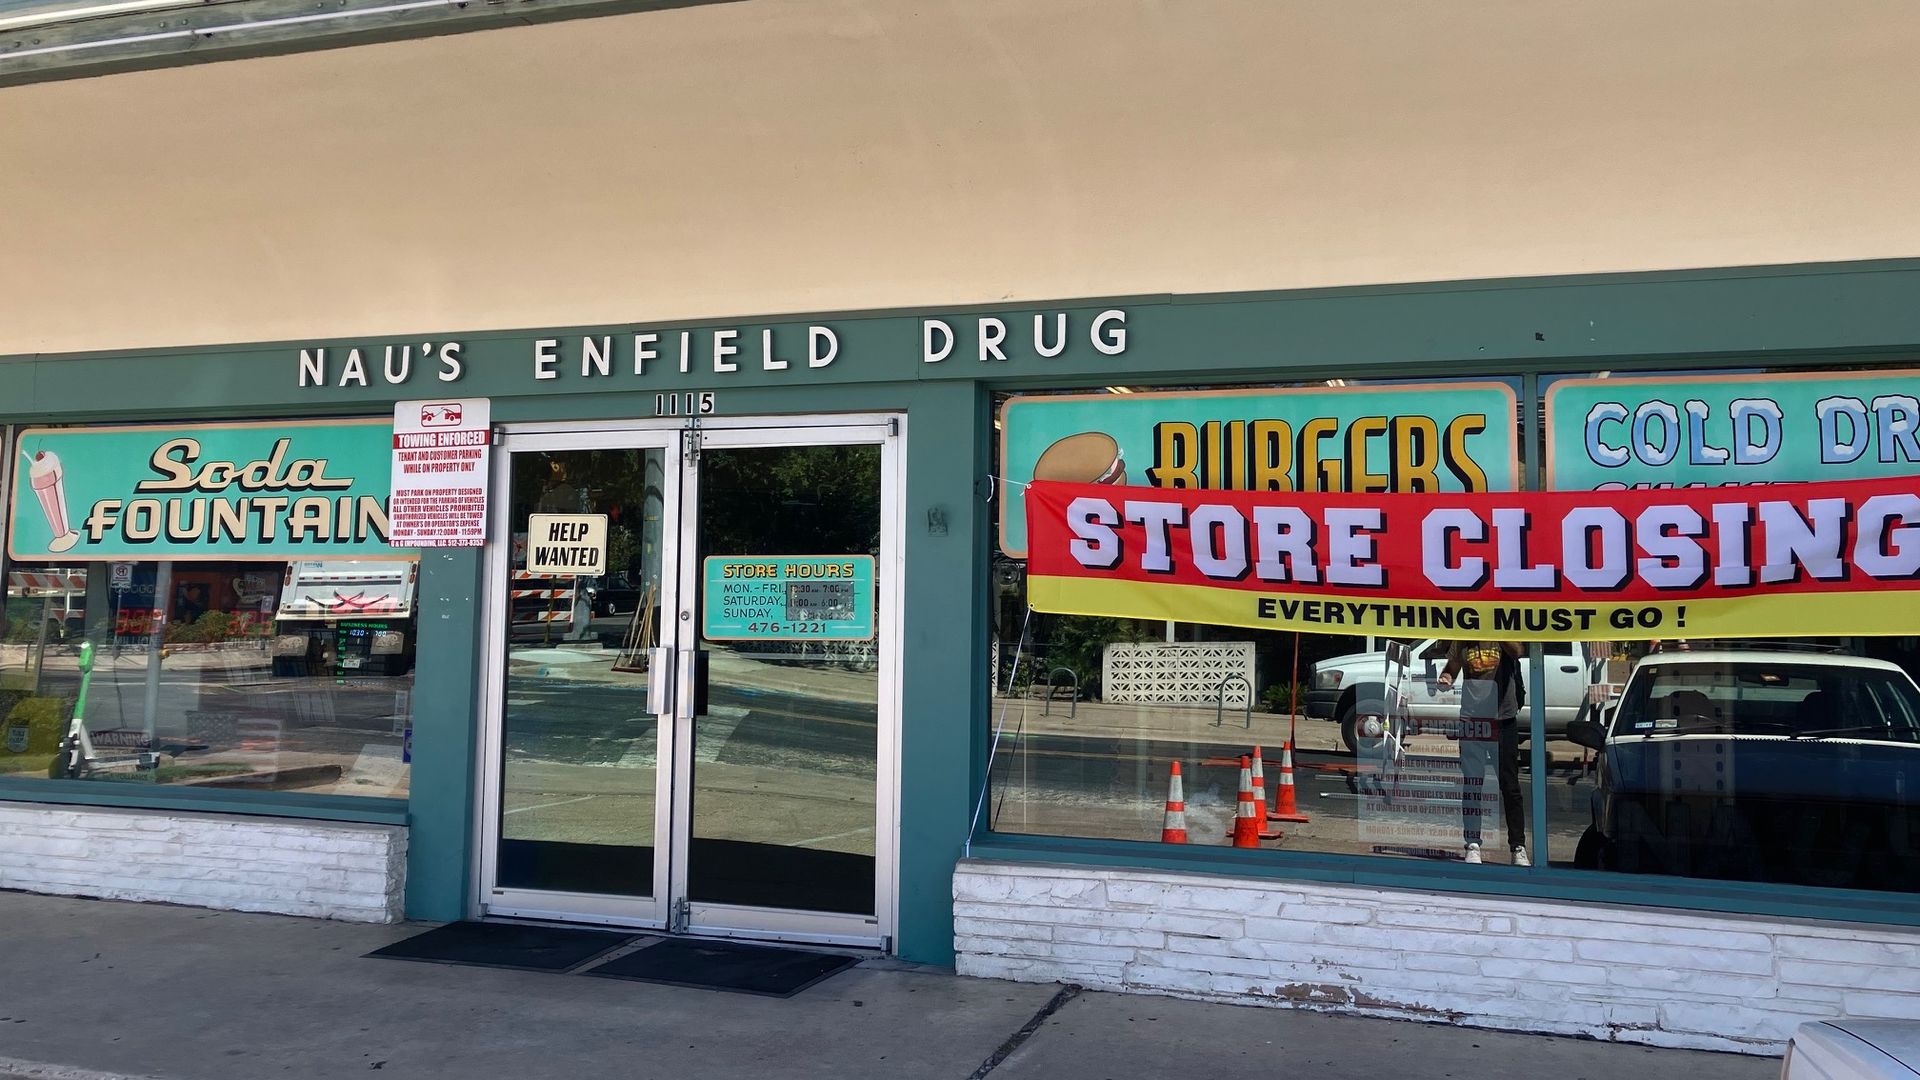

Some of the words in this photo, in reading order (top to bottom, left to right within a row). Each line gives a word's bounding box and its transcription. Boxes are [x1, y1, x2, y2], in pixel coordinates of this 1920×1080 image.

[298, 341, 463, 387] NAU'S
[534, 326, 839, 380] ENFIELD
[923, 309, 1127, 363] DRUG
[656, 392, 714, 415] 1115
[398, 433, 436, 448] TOWING
[437, 431, 485, 446] ENFORCED
[1585, 397, 1783, 468] COLD
[398, 451, 417, 461] TENANT
[418, 451, 429, 461] AND
[430, 450, 457, 460] CUSTOMER
[459, 449, 482, 459] PARKING
[133, 437, 355, 493] Soda
[404, 463, 421, 473] WHILE
[422, 463, 430, 473] ON
[431, 462, 460, 472] PROPERTY
[461, 461, 475, 471] ONLY
[396, 489, 410, 497] MUST
[432, 488, 457, 496] PROPERTY
[400, 497, 420, 505] INTENDED
[393, 505, 402, 513] ALL
[403, 505, 422, 513] OTHER
[450, 504, 485, 512] PROHIBITED
[83, 495, 390, 545] FOUNTAIN
[548, 522, 589, 542] HELP
[1066, 496, 1388, 588] STORE
[1421, 493, 1920, 592] CLOSING
[535, 547, 599, 567] WANTED
[723, 563, 778, 578] STORE
[784, 563, 855, 578] HOURS
[1257, 597, 1481, 630] EVERYTHING
[1493, 606, 1596, 631] MUST
[1609, 605, 1663, 629] GO
[747, 622, 827, 633] 476-1221
[1421, 719, 1491, 738] ENFORCED
[91, 733, 150, 746] WARNING
